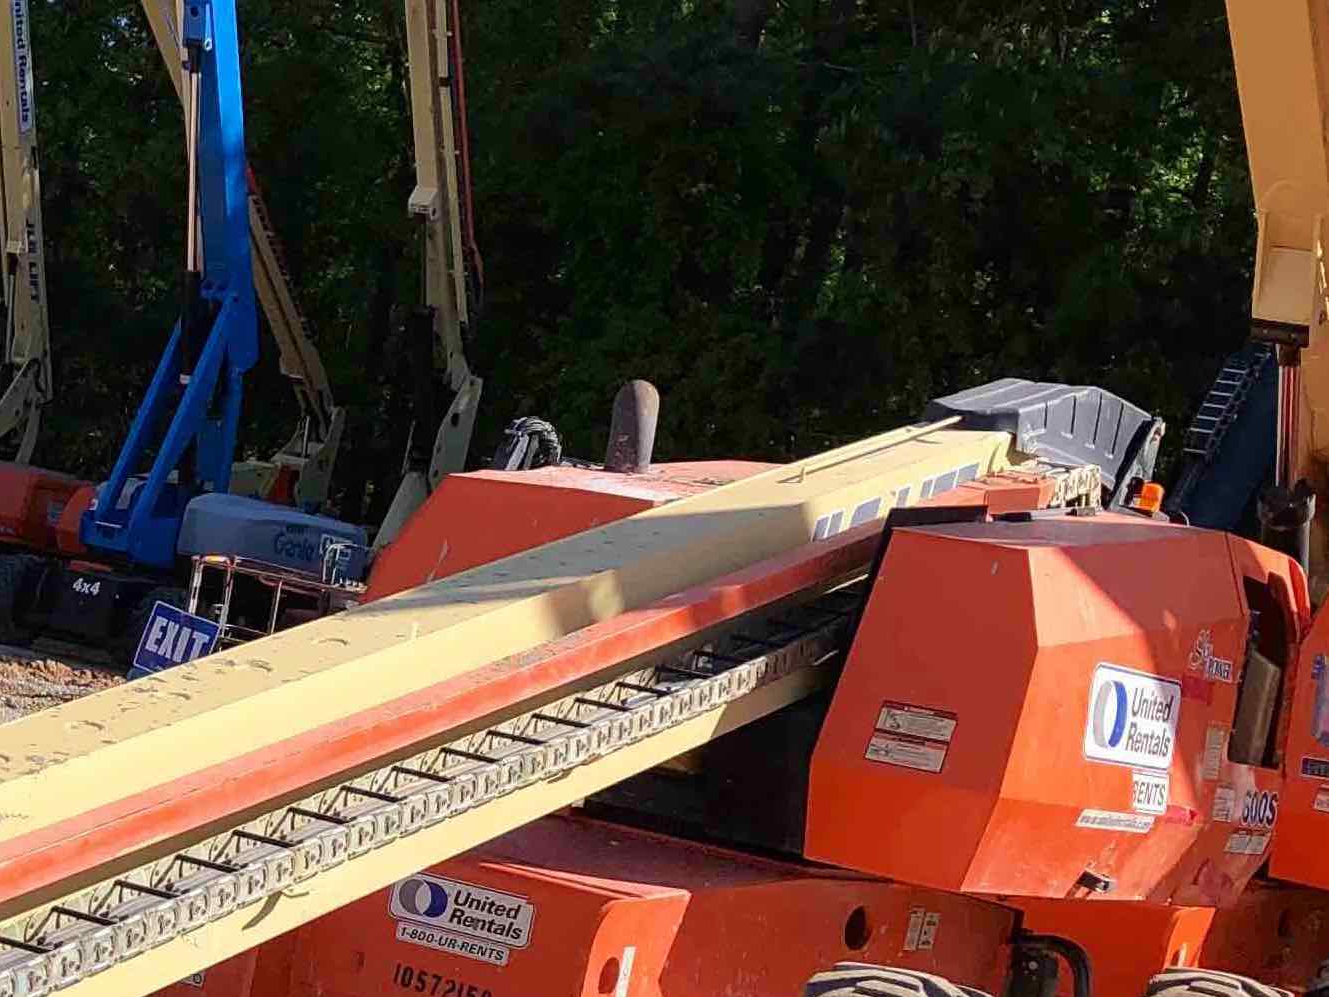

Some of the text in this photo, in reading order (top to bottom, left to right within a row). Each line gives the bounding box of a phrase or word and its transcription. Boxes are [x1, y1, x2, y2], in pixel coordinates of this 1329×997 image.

[18, 54, 30, 123] Rentals
[72, 577, 101, 596] 4x4
[145, 615, 210, 663] EXIT
[1131, 687, 1174, 723] United
[1125, 722, 1171, 758] Rentals
[453, 889, 521, 920] United
[448, 907, 523, 940] Rentals
[400, 926, 505, 961] 1-800-UR-RENTS
